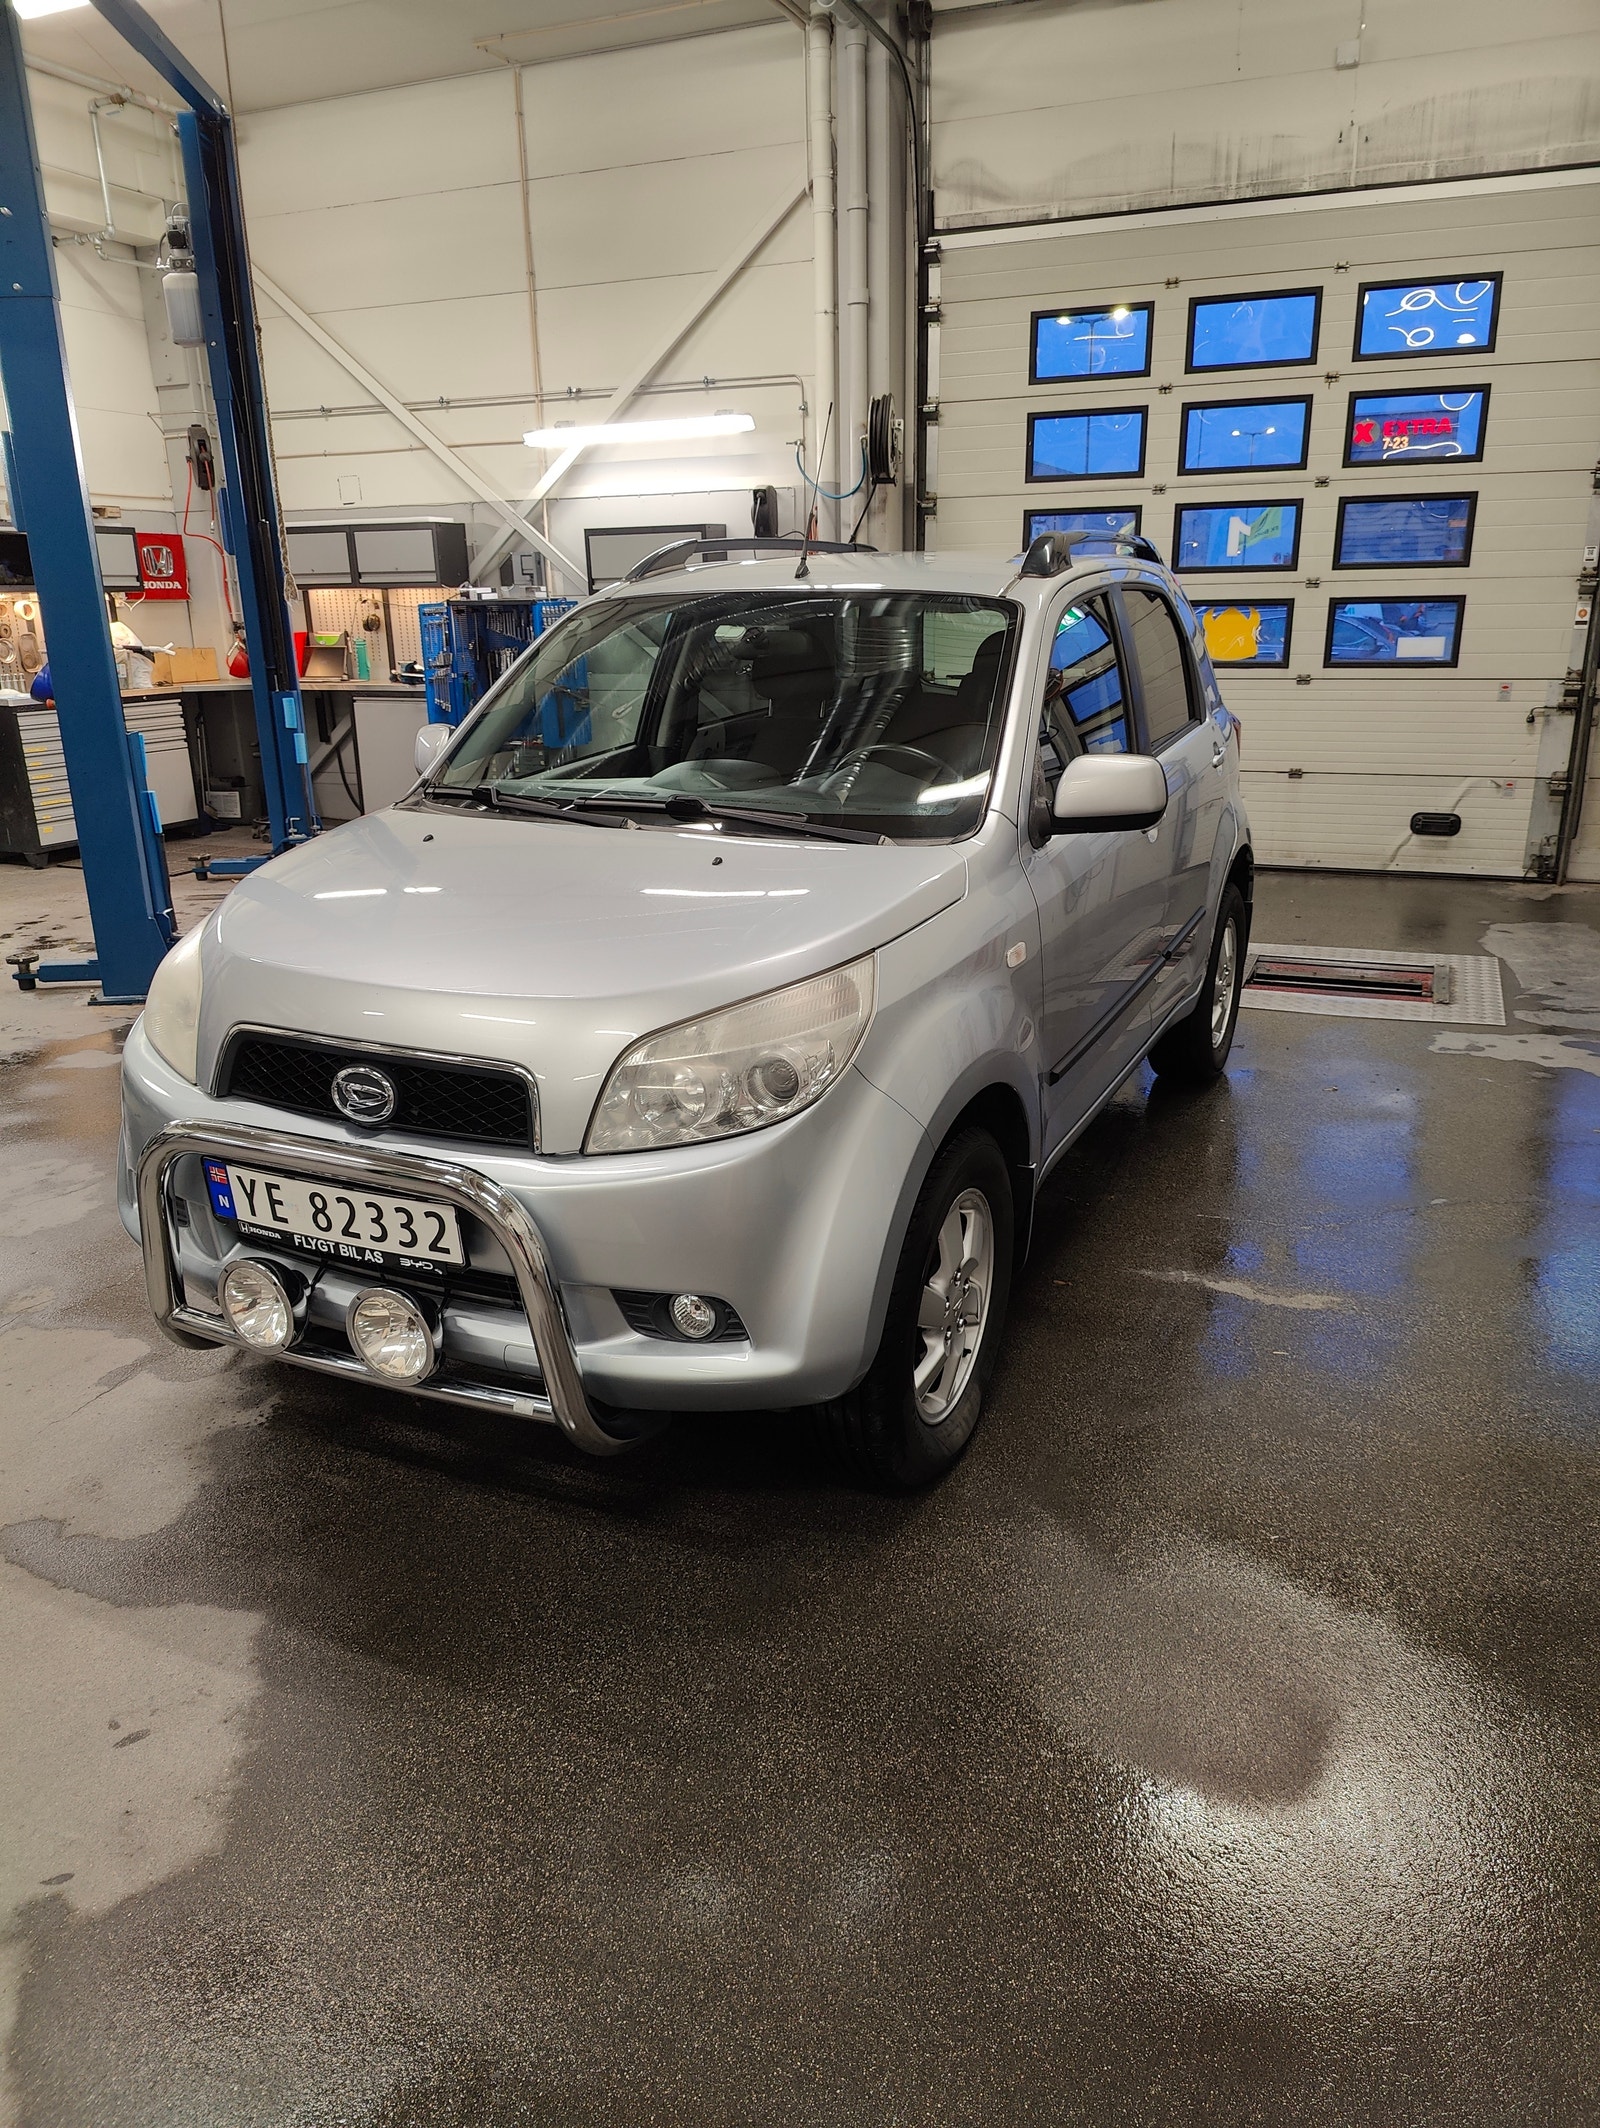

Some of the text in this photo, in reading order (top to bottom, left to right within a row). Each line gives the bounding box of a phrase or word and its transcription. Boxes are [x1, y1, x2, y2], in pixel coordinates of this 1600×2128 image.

[1383, 418, 1452, 437] EXTRA
[1383, 437, 1408, 450] 7-23
[218, 1194, 230, 1209] N
[236, 1174, 451, 1255] YE 82332
[249, 1226, 282, 1239] HONDA
[293, 1234, 384, 1264] FLYGT BIL AS
